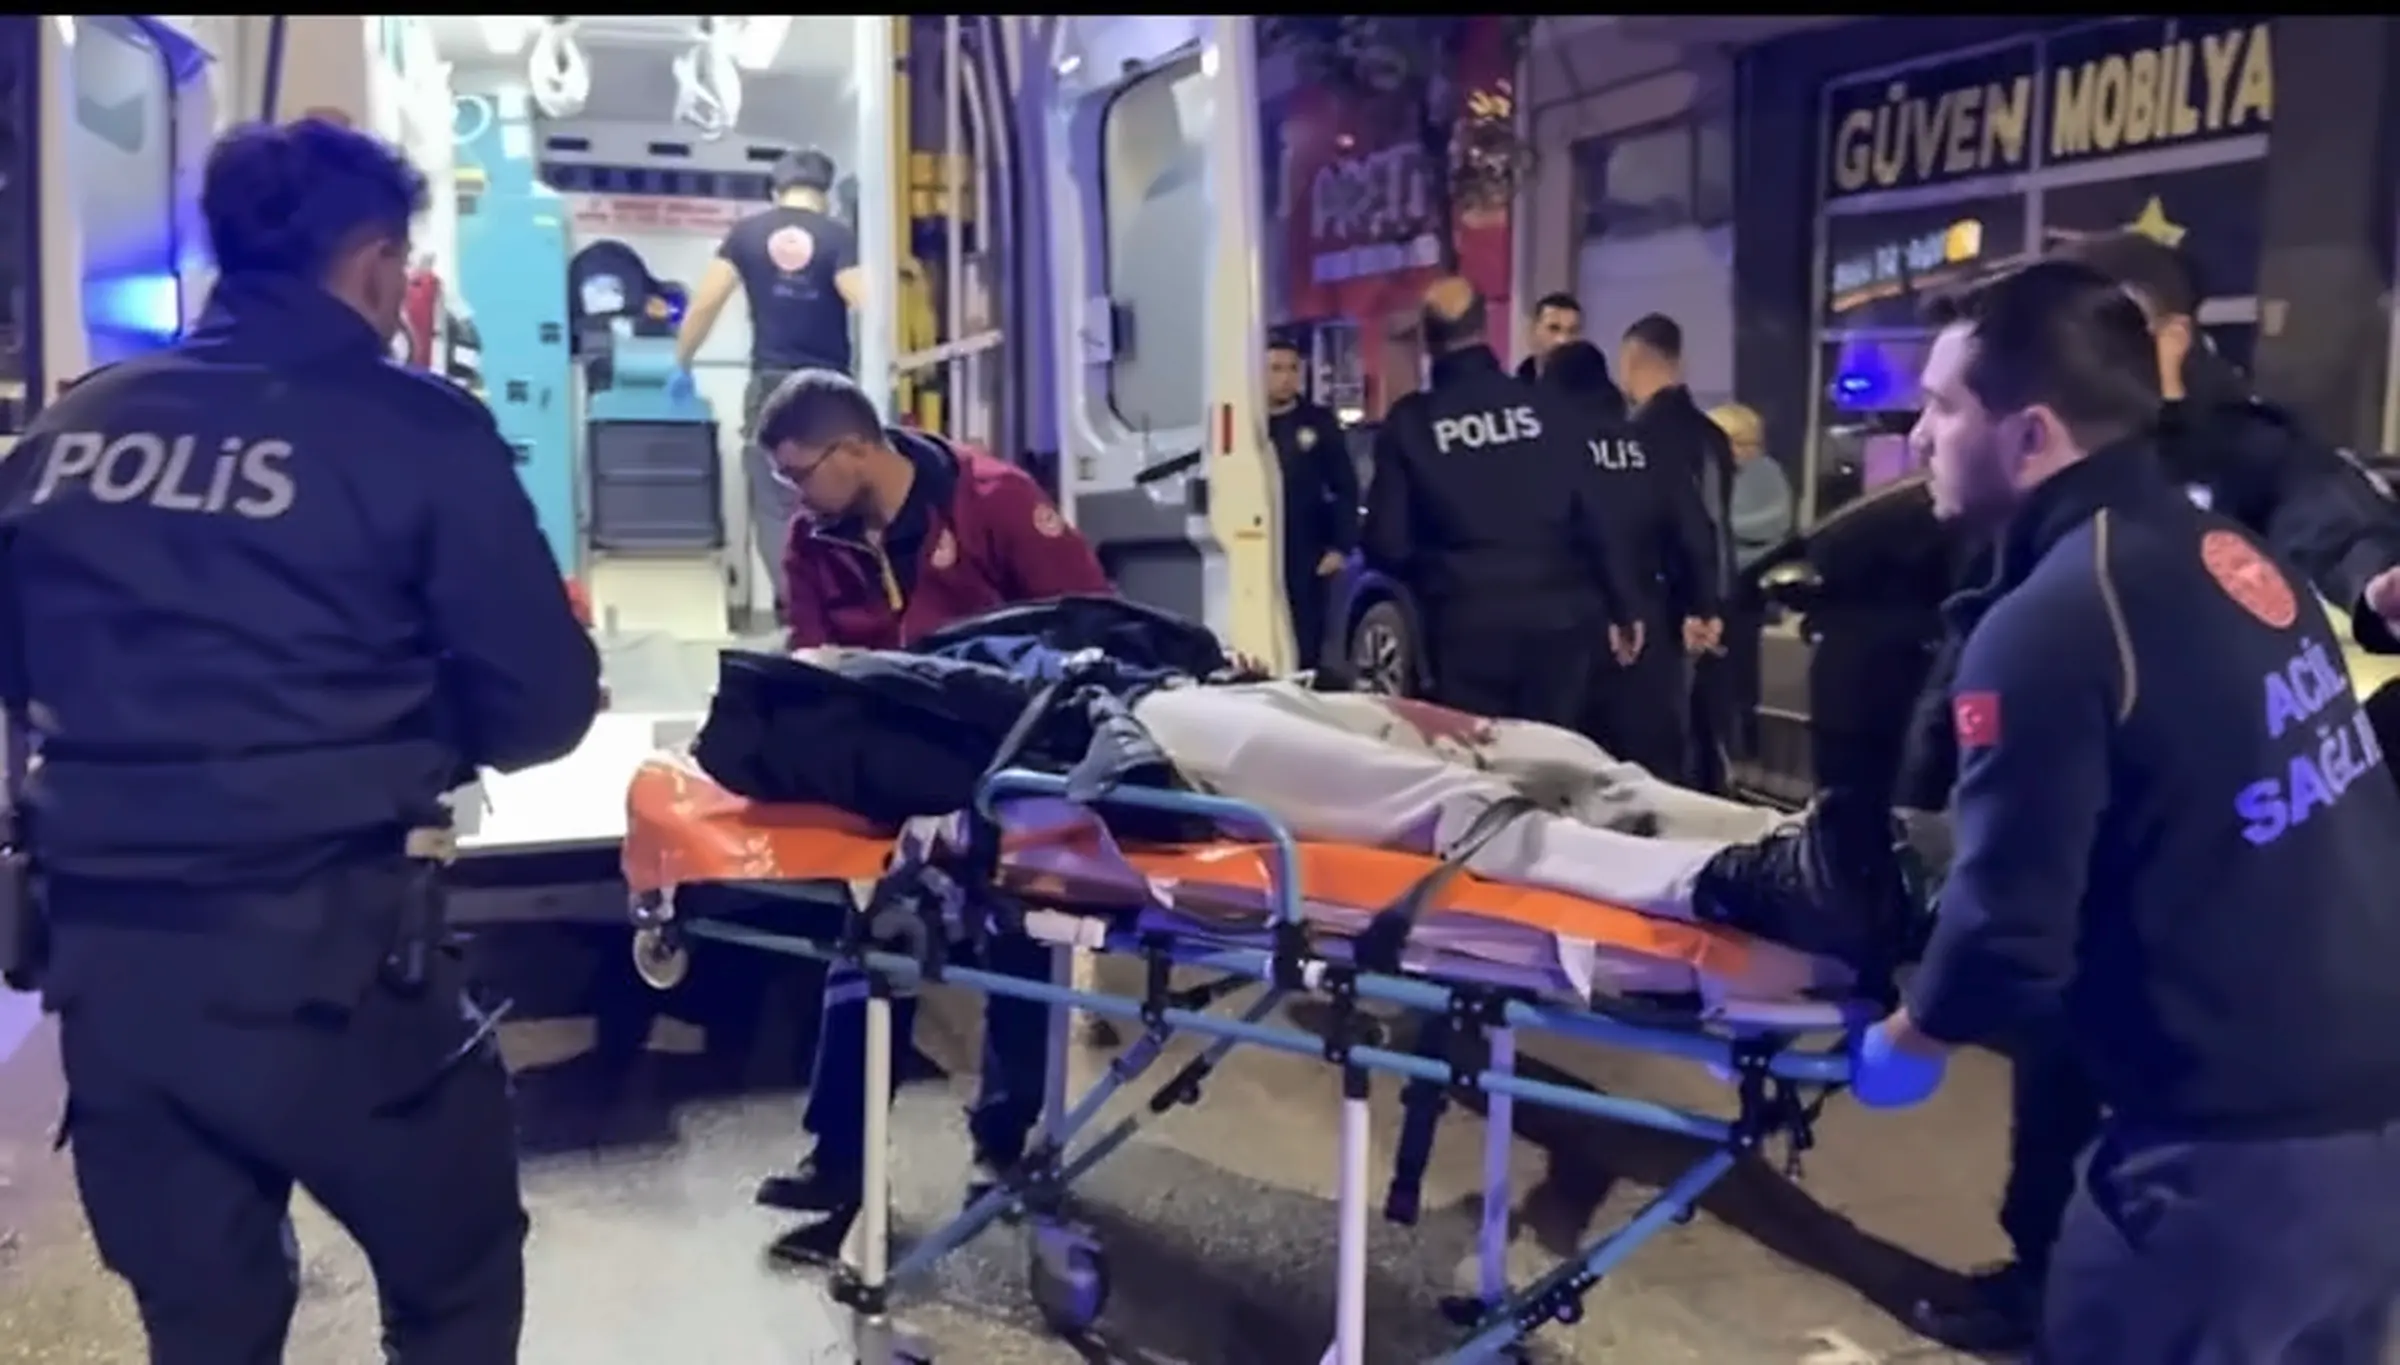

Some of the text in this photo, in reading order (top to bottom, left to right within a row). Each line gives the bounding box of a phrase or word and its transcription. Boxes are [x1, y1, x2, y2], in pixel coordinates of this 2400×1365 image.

[1834, 81, 2032, 190] GÜVEN
[2264, 637, 2346, 739] ACİL
[2234, 708, 2383, 844] SAĞLI
